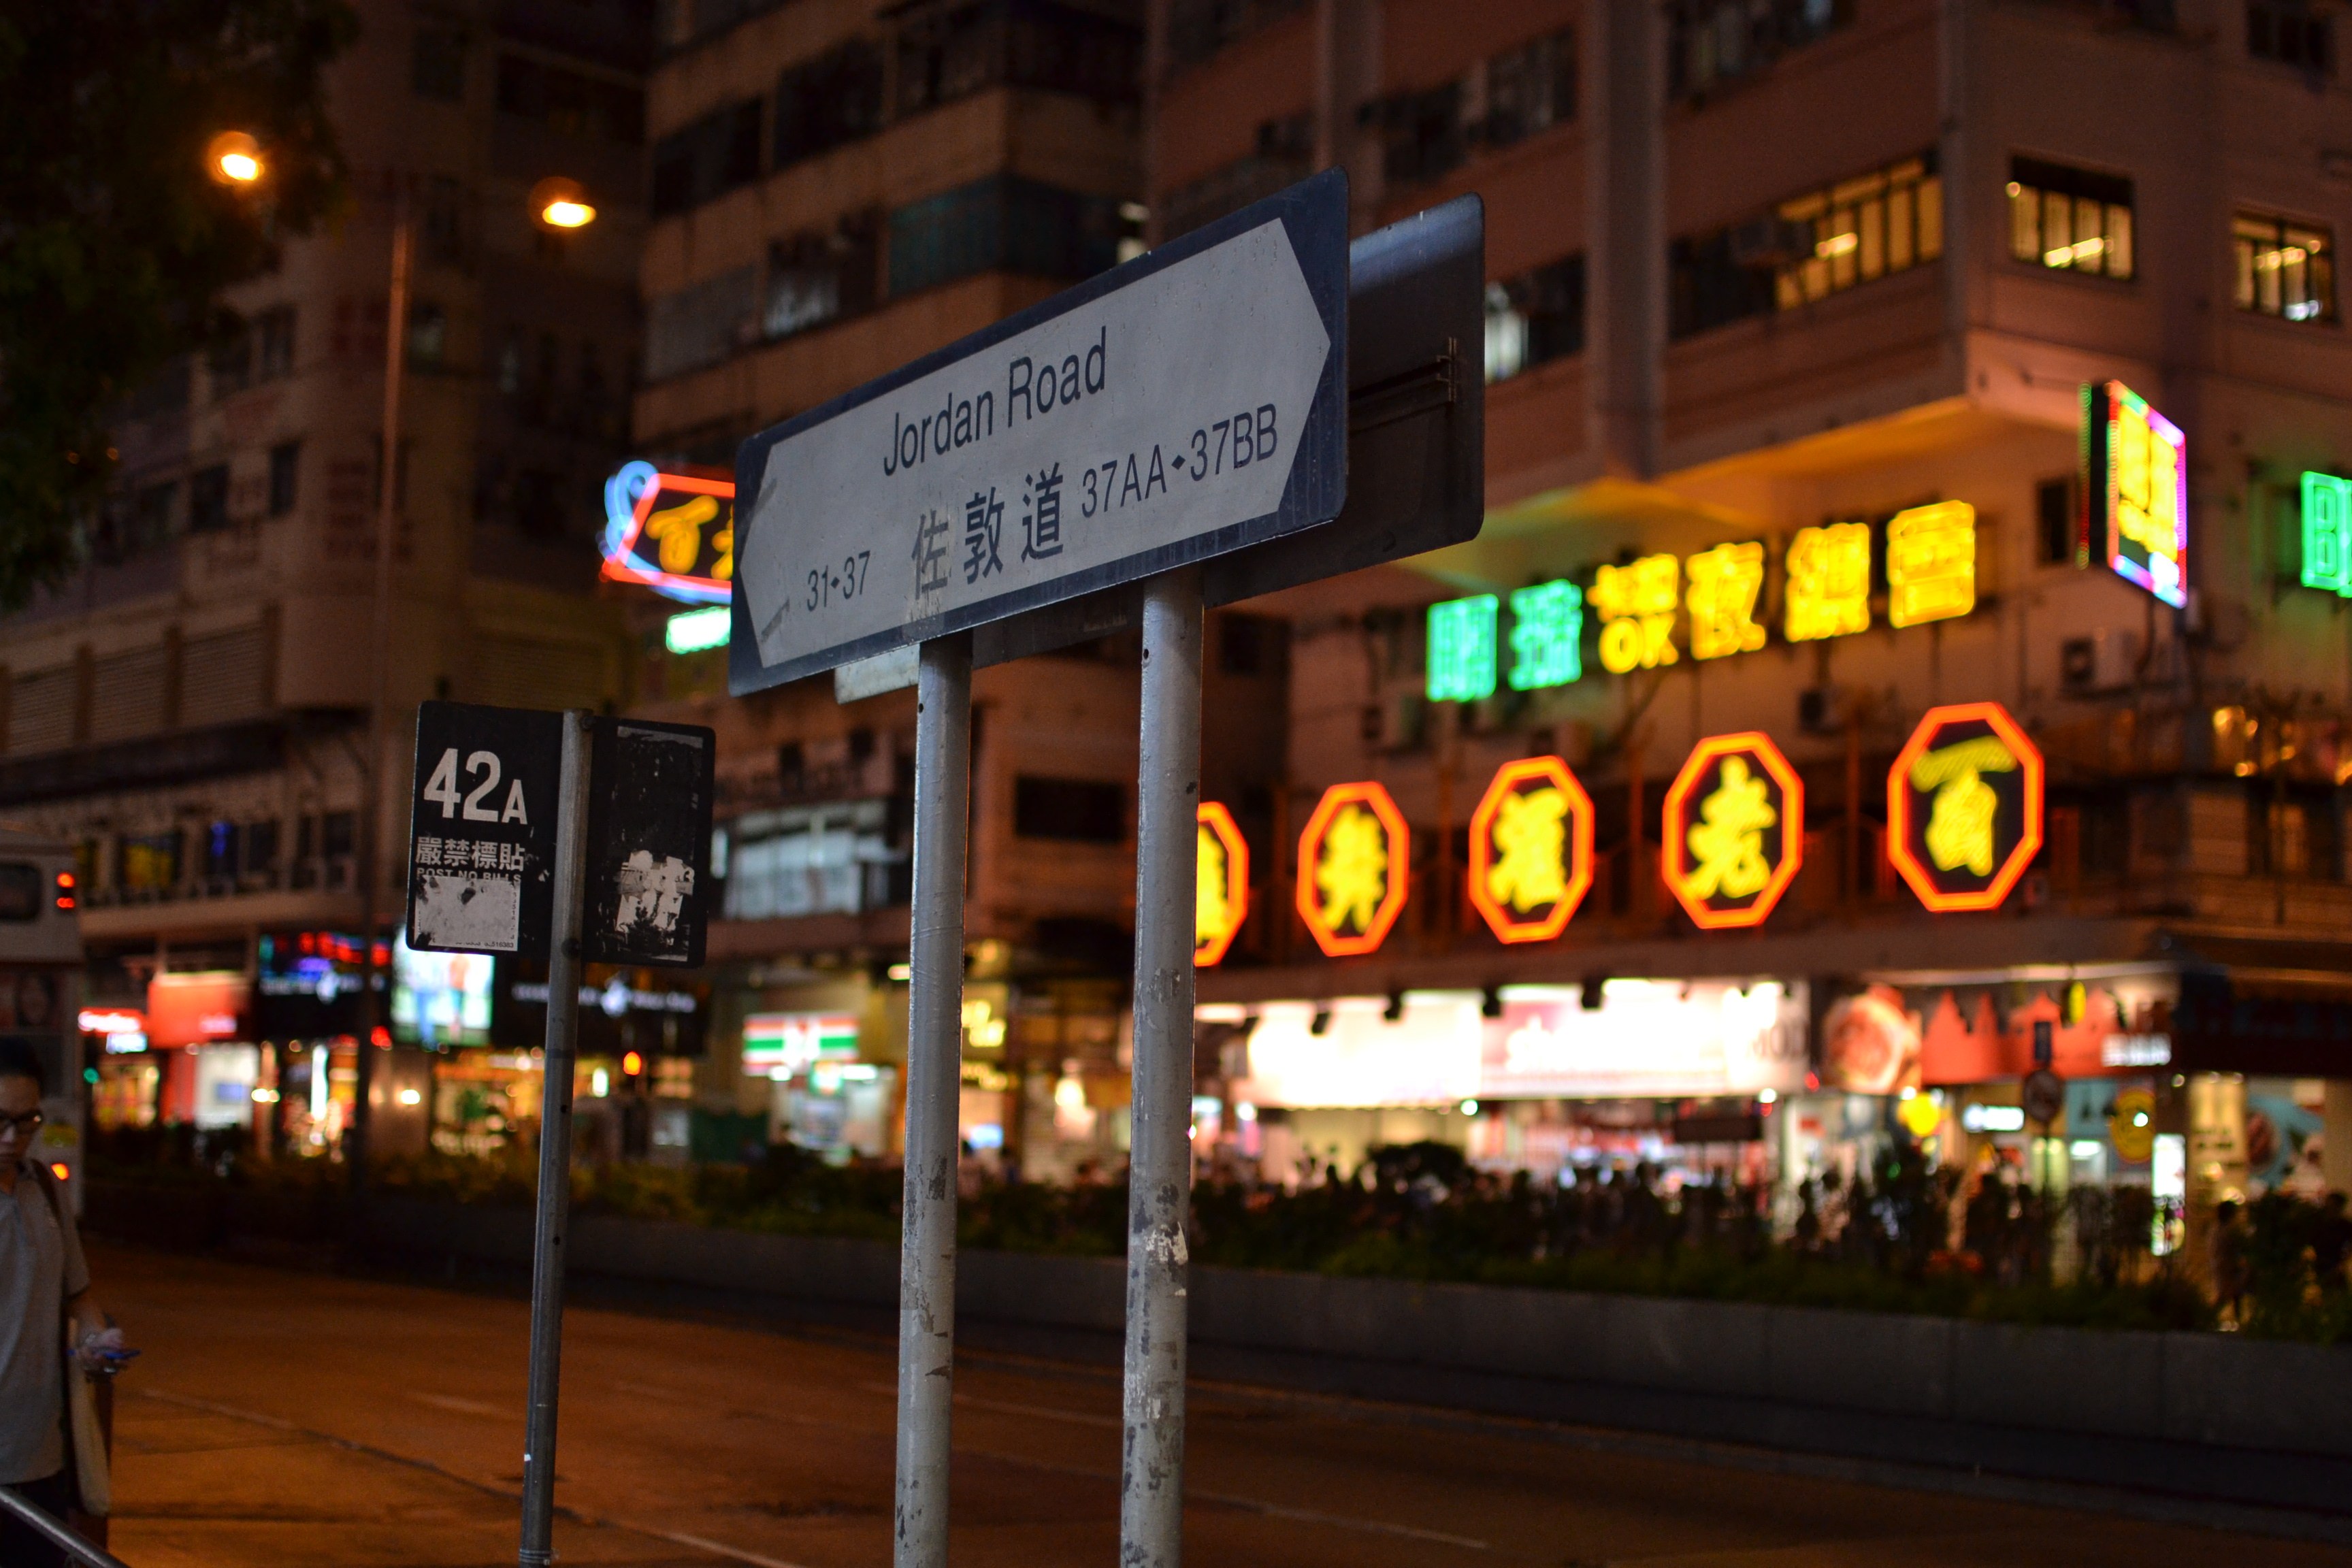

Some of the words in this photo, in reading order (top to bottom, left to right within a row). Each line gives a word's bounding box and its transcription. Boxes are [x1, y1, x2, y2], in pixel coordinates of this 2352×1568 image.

[883, 389, 994, 476] Jordan
[1008, 326, 1107, 428] Road
[911, 463, 1064, 601] 佐敦道
[423, 747, 528, 826] 42A
[414, 836, 526, 872] 嚴禁標貼
